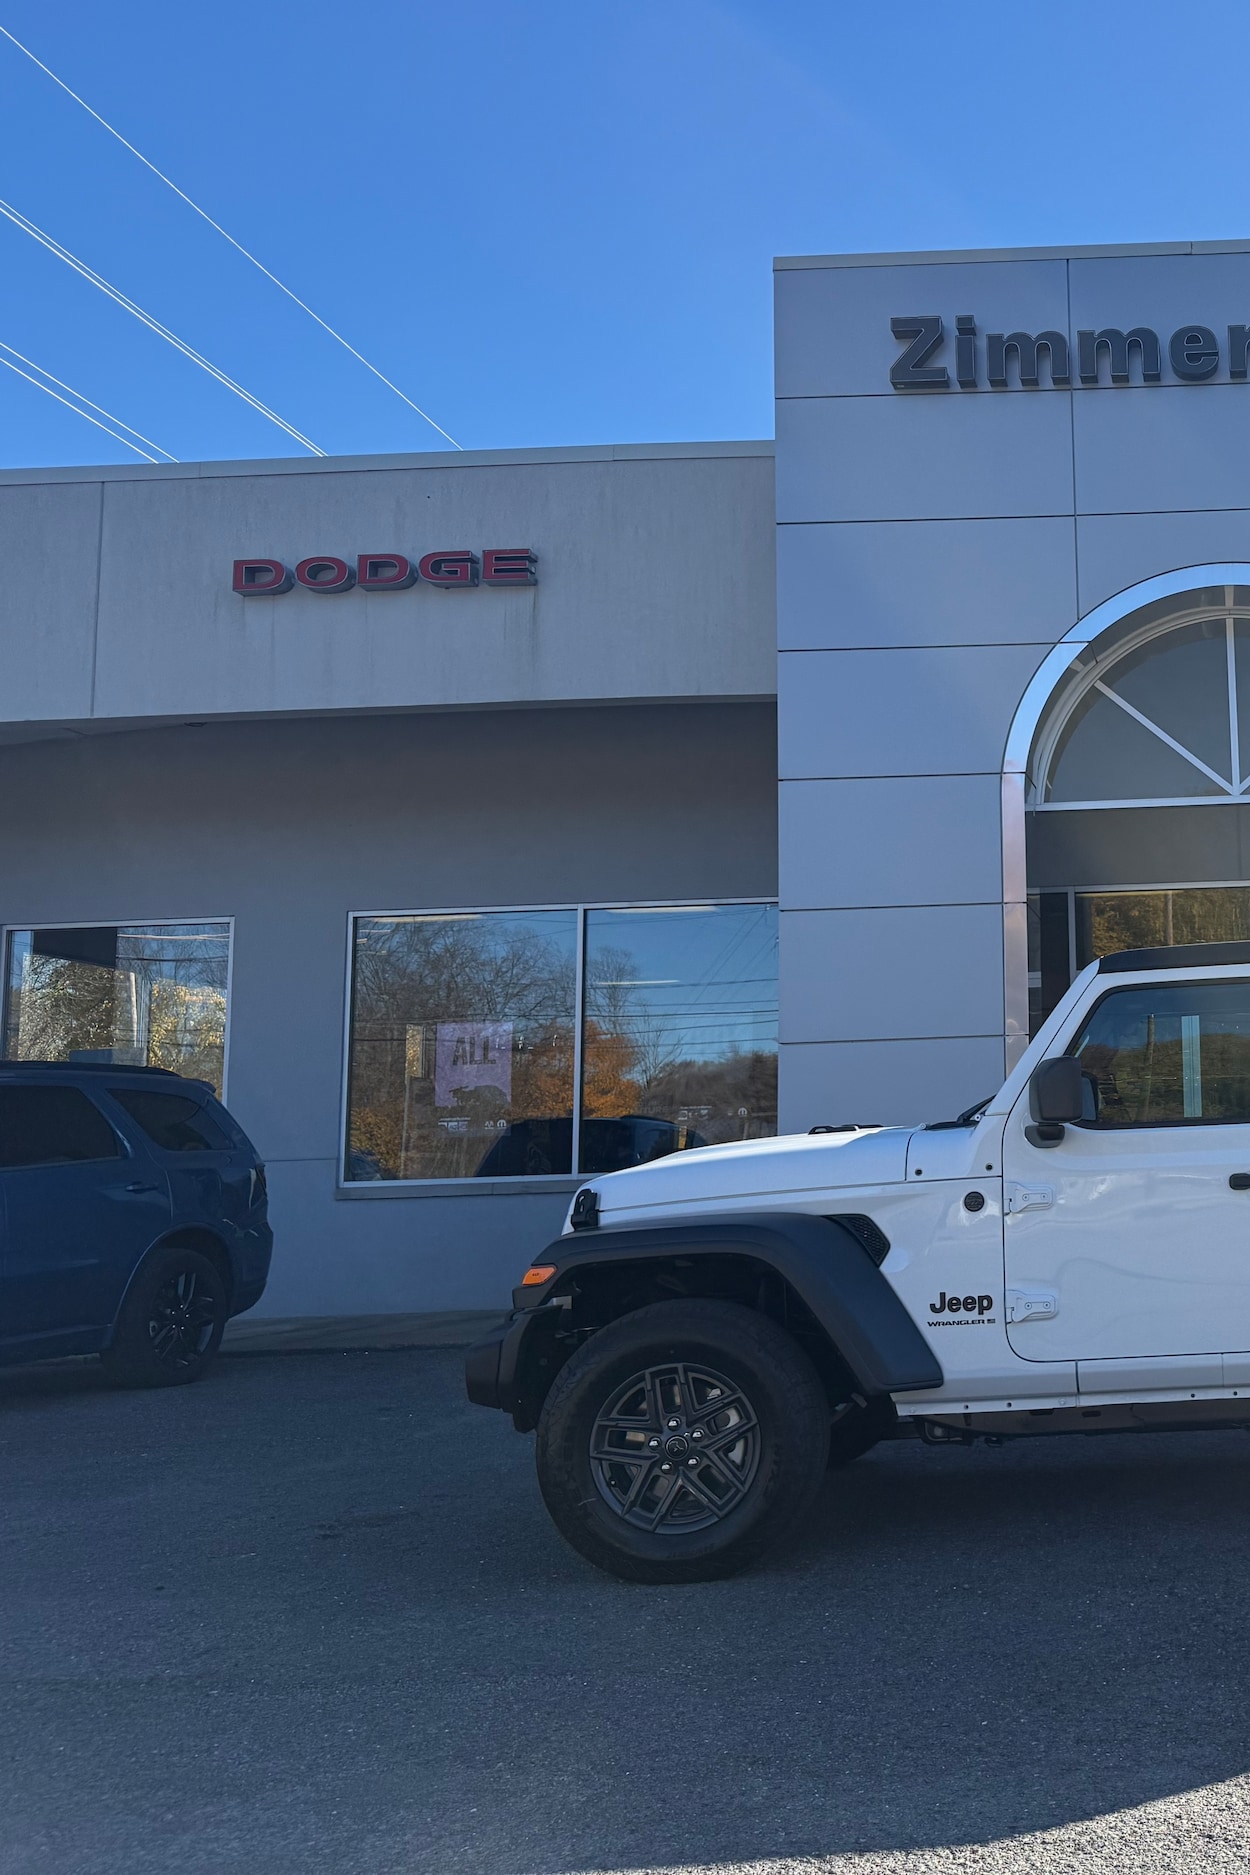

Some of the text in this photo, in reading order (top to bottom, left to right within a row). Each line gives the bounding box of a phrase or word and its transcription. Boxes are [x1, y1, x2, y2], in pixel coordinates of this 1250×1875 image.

[232, 548, 538, 597] DODGE
[452, 1036, 497, 1066] ALL
[929, 1291, 993, 1316] Jeep
[927, 1319, 986, 1328] WRANGLER
